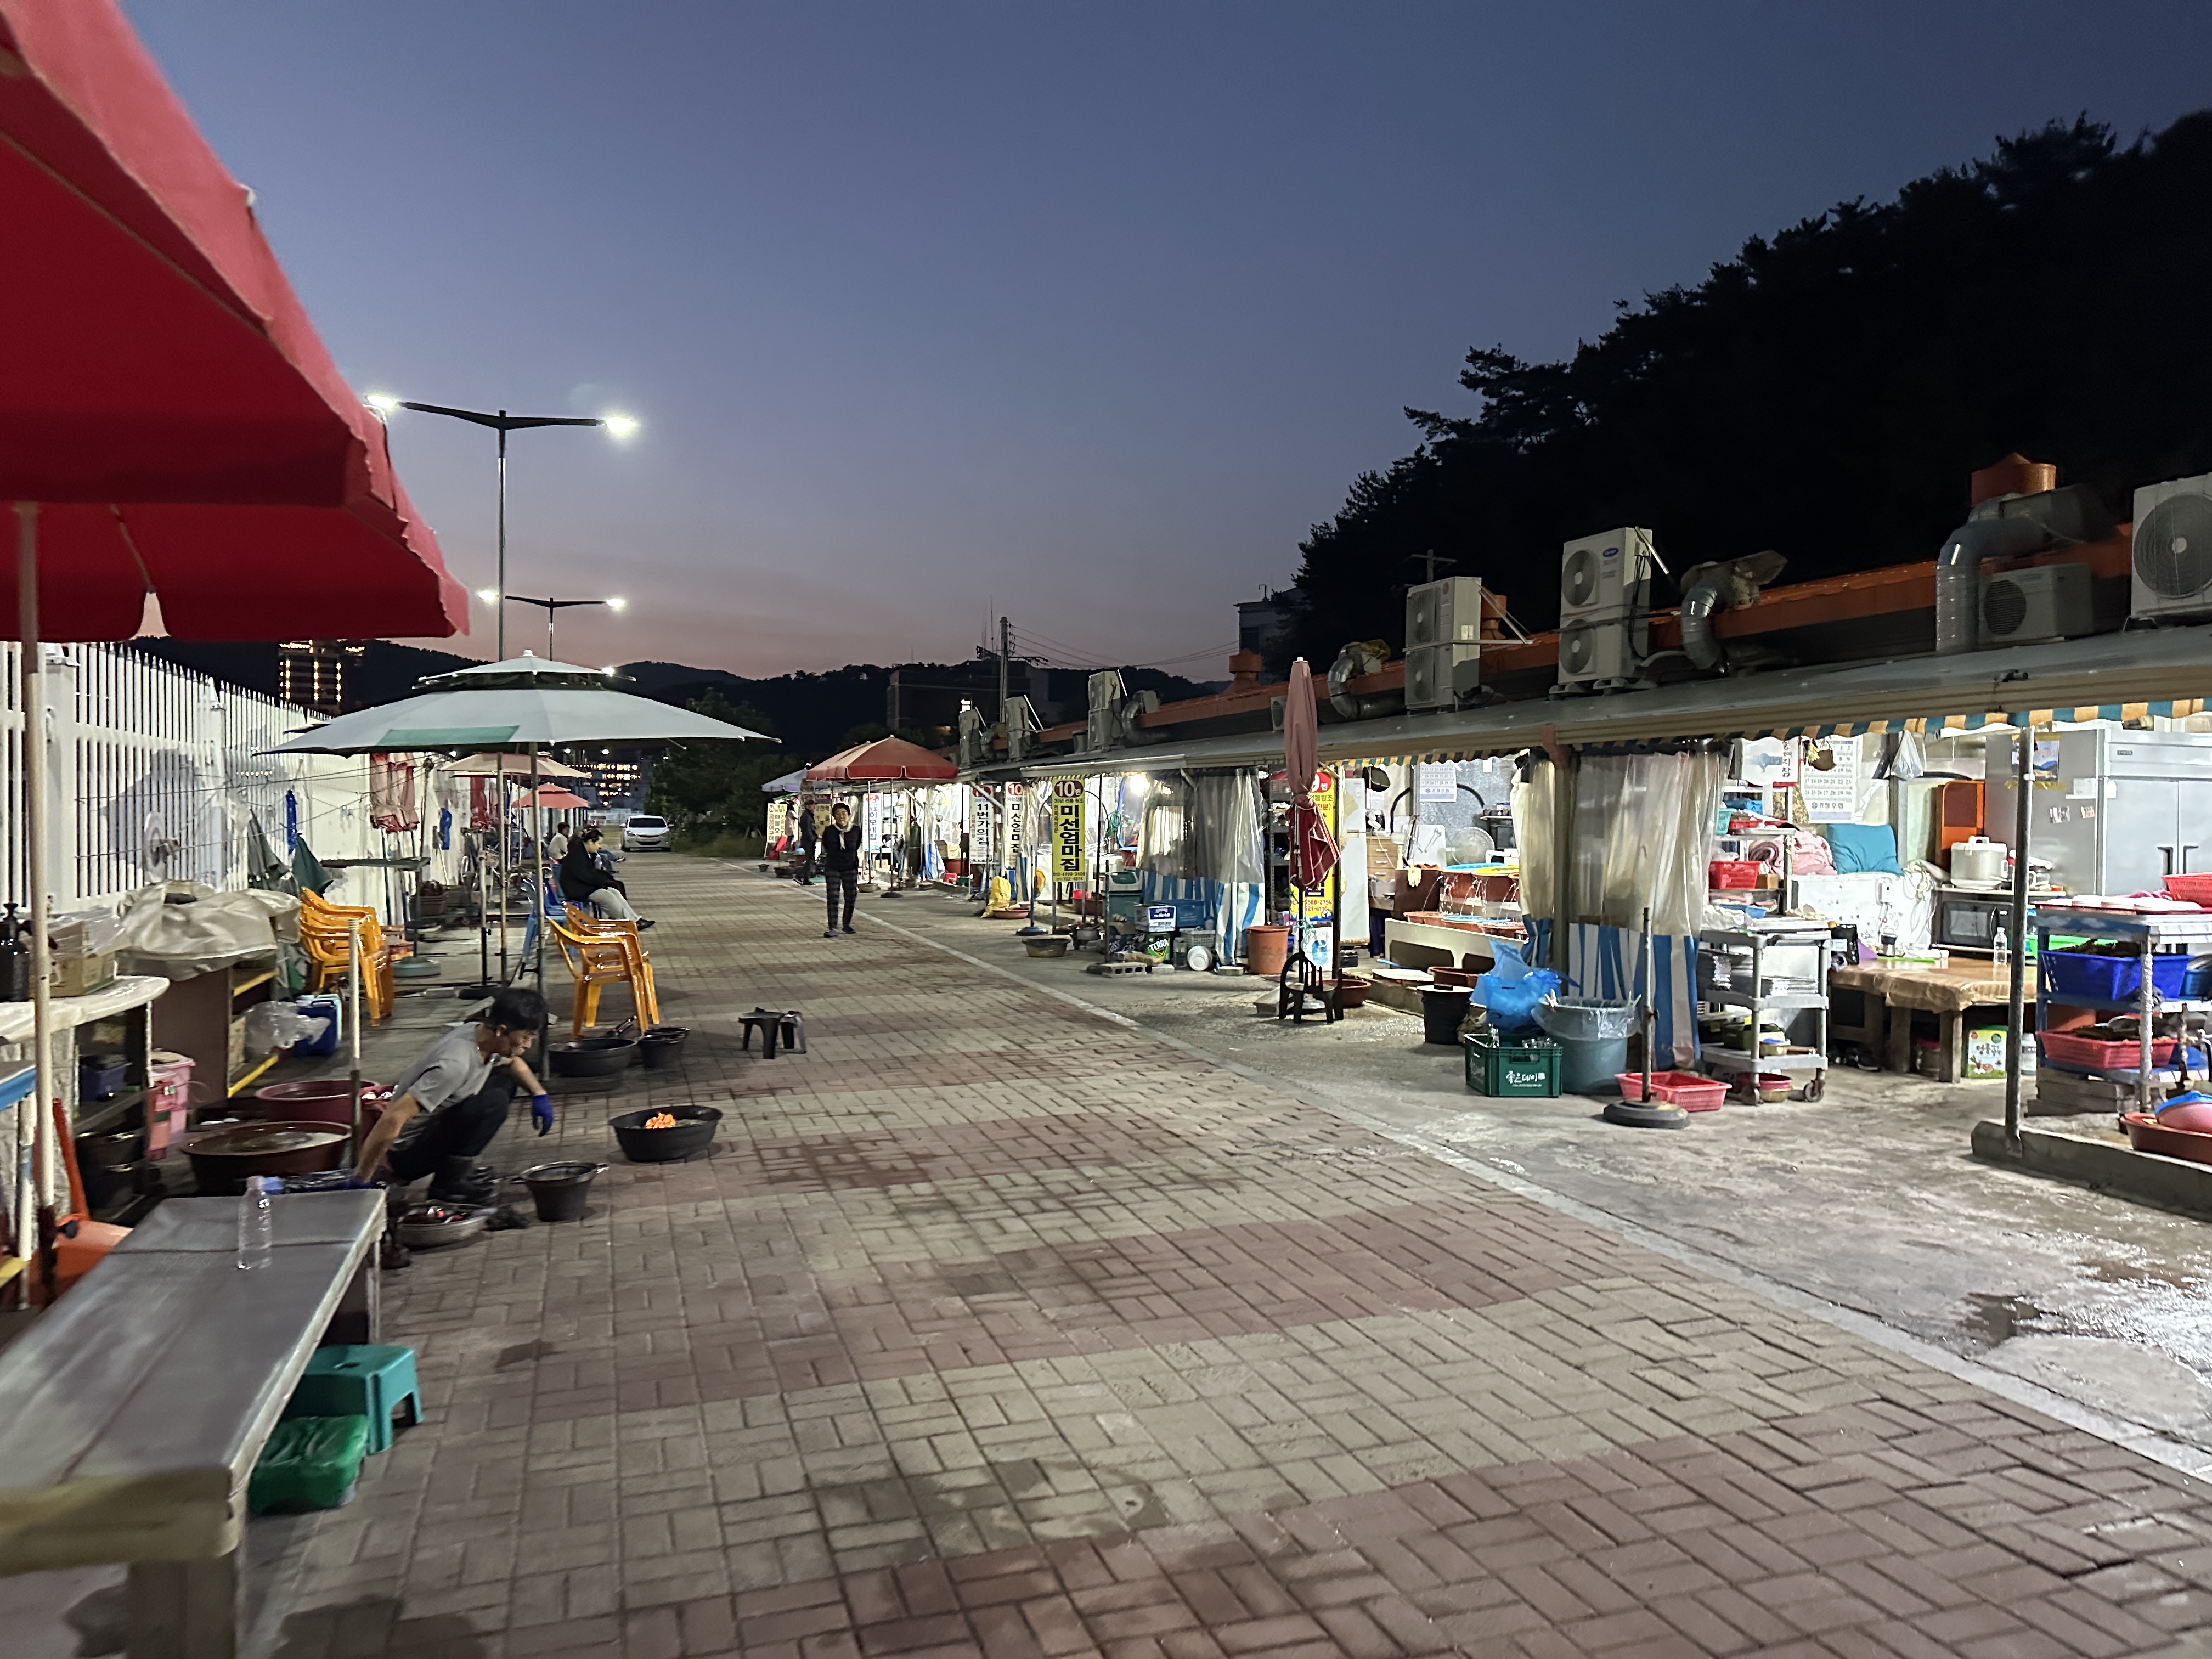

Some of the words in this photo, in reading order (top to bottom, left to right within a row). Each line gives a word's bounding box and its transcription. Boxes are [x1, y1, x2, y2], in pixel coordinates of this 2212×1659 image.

[1056, 781, 1081, 797] 10번
[1059, 805, 1082, 871] 미선엄마집
[1148, 938, 1170, 952] TERRA
[1505, 1070, 1538, 1084] 좋은데이
